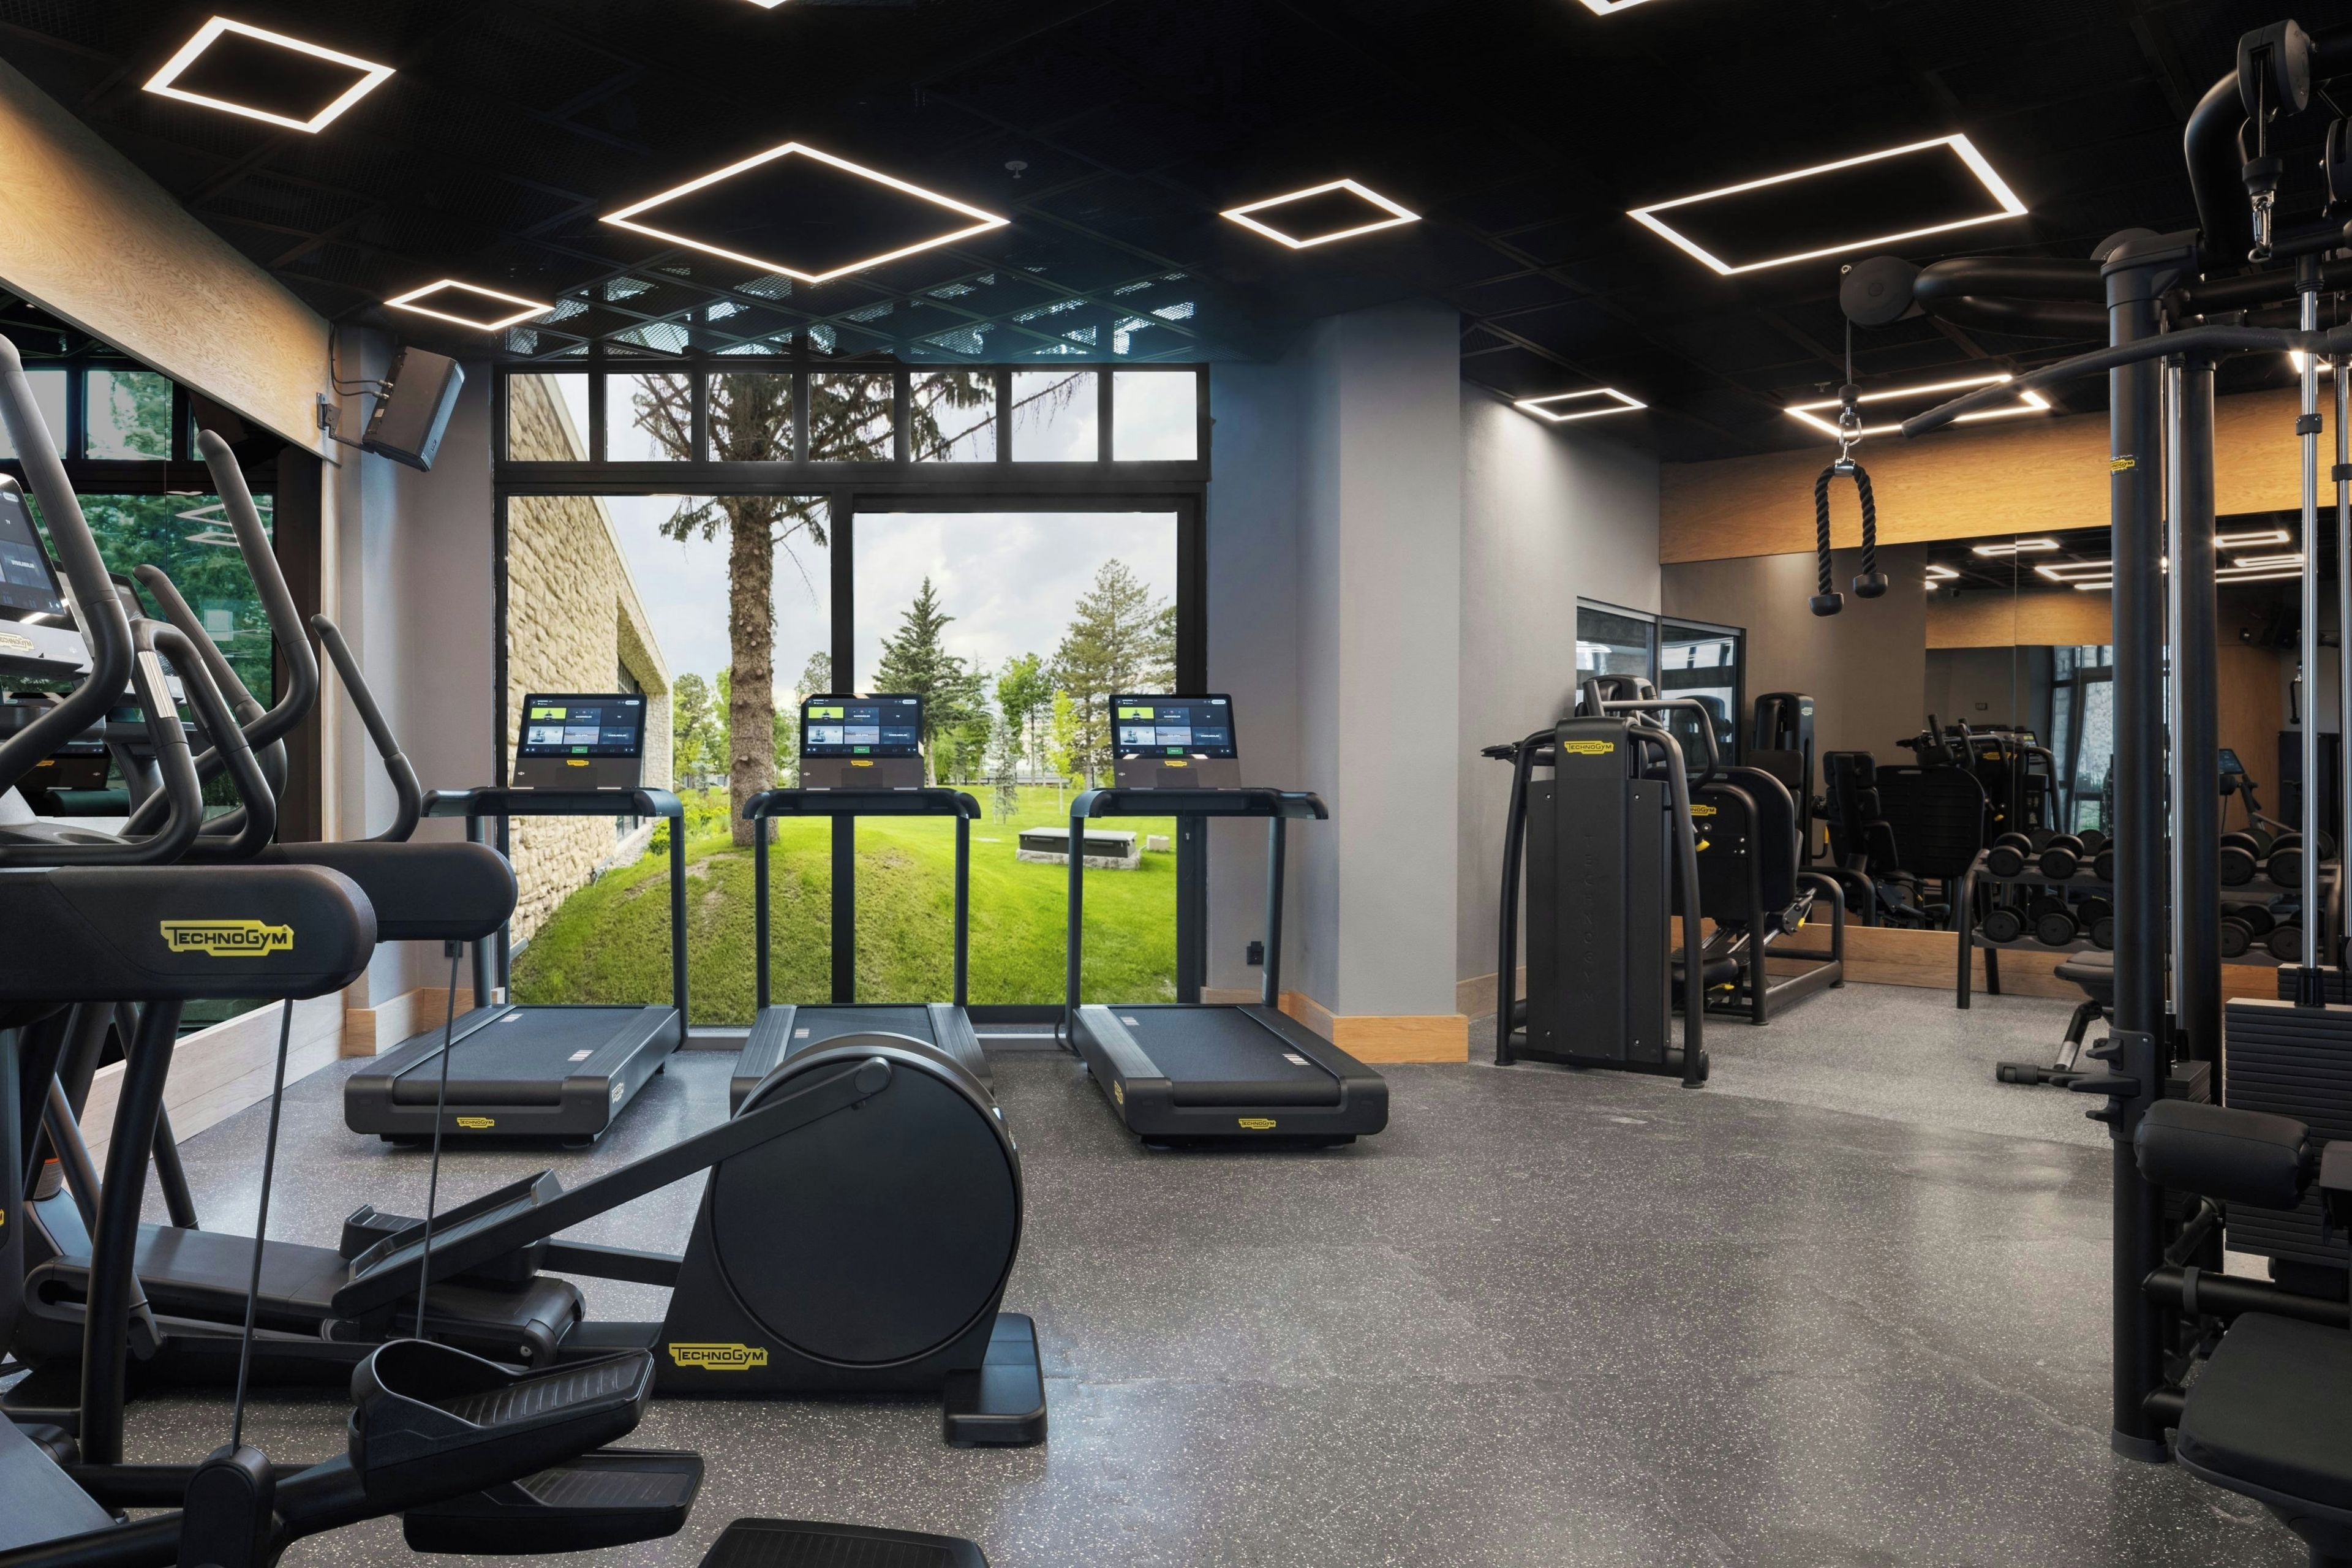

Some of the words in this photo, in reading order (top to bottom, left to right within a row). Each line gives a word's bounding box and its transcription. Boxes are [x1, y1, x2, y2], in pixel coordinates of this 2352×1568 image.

[1566, 742, 1612, 752] TECHNOGYM
[164, 926, 288, 951] TECHNOGYM
[671, 1347, 764, 1365] TECHNOGYM
